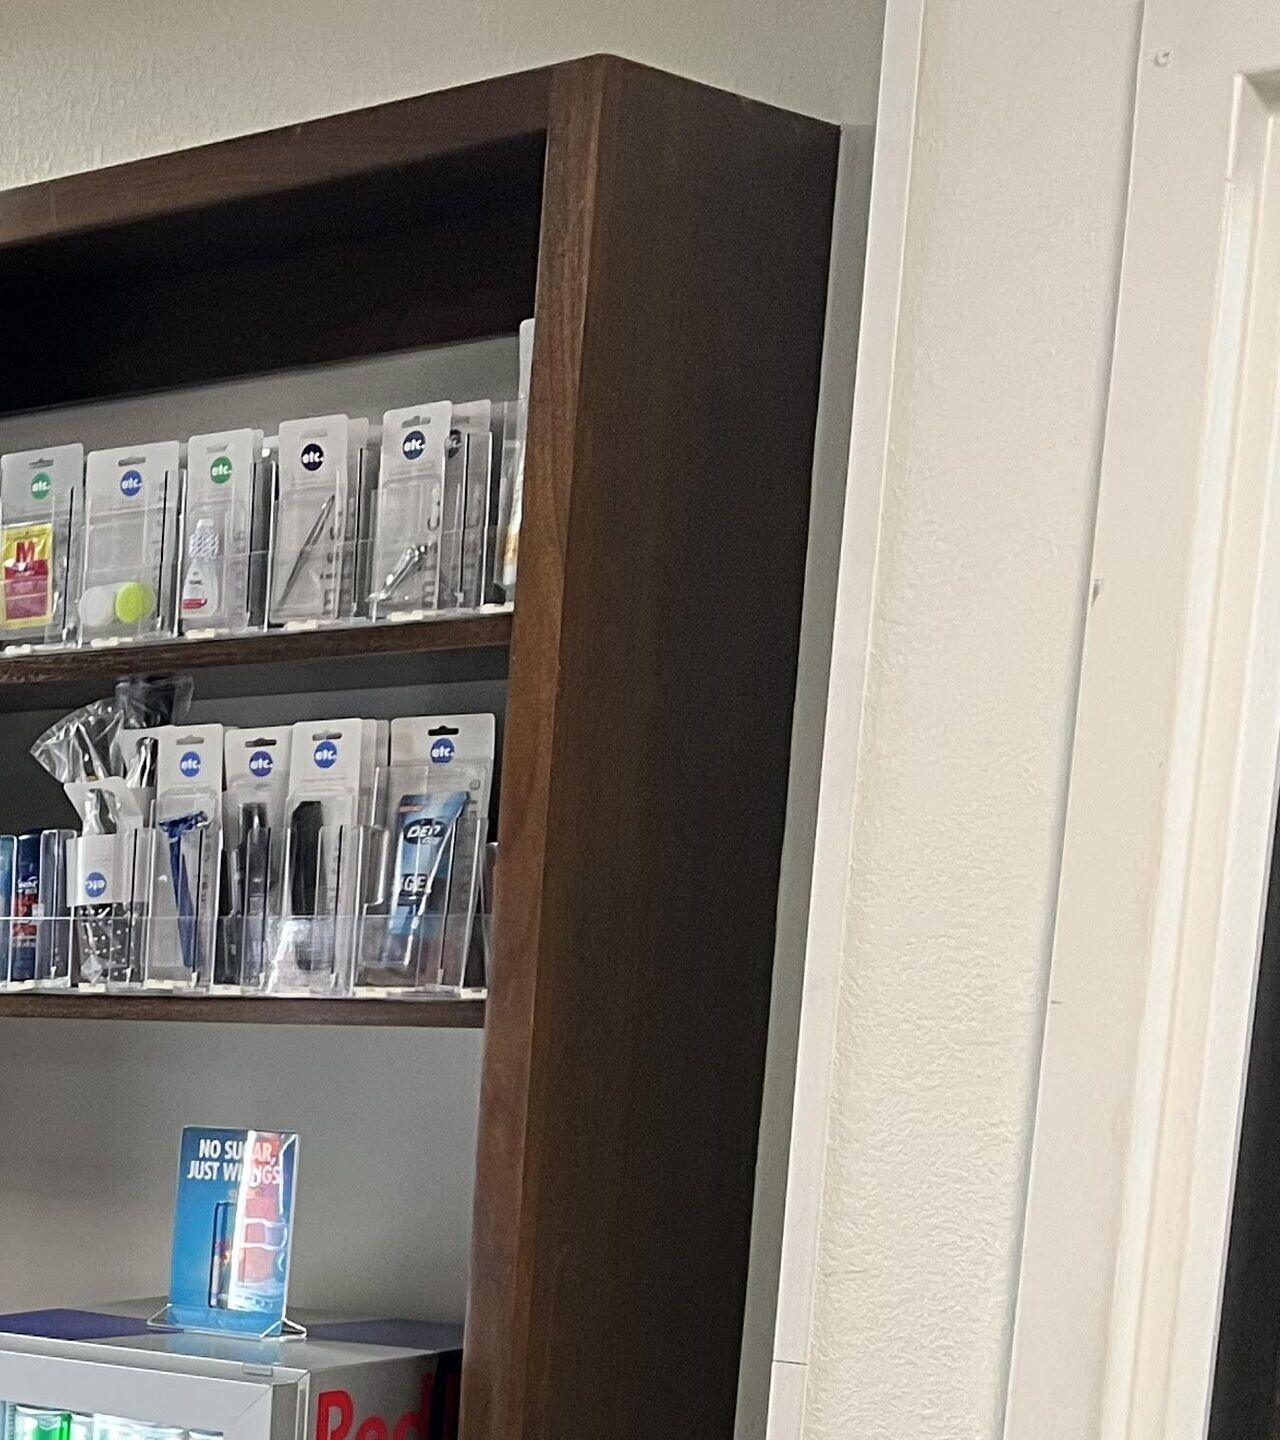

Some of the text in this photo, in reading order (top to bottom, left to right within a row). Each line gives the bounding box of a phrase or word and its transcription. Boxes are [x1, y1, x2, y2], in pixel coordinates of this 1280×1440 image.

[404, 439, 425, 452] etc.
[301, 451, 324, 464] etc.
[211, 463, 232, 476] etc.
[32, 481, 51, 492] etc.
[121, 477, 143, 490] etc.
[315, 750, 338, 761] etc.
[431, 745, 455, 757] etc.
[180, 760, 202, 771] etc.
[249, 759, 274, 770] etc.
[199, 1139, 277, 1165] NO SUAR,
[187, 1160, 218, 1180] JUST
